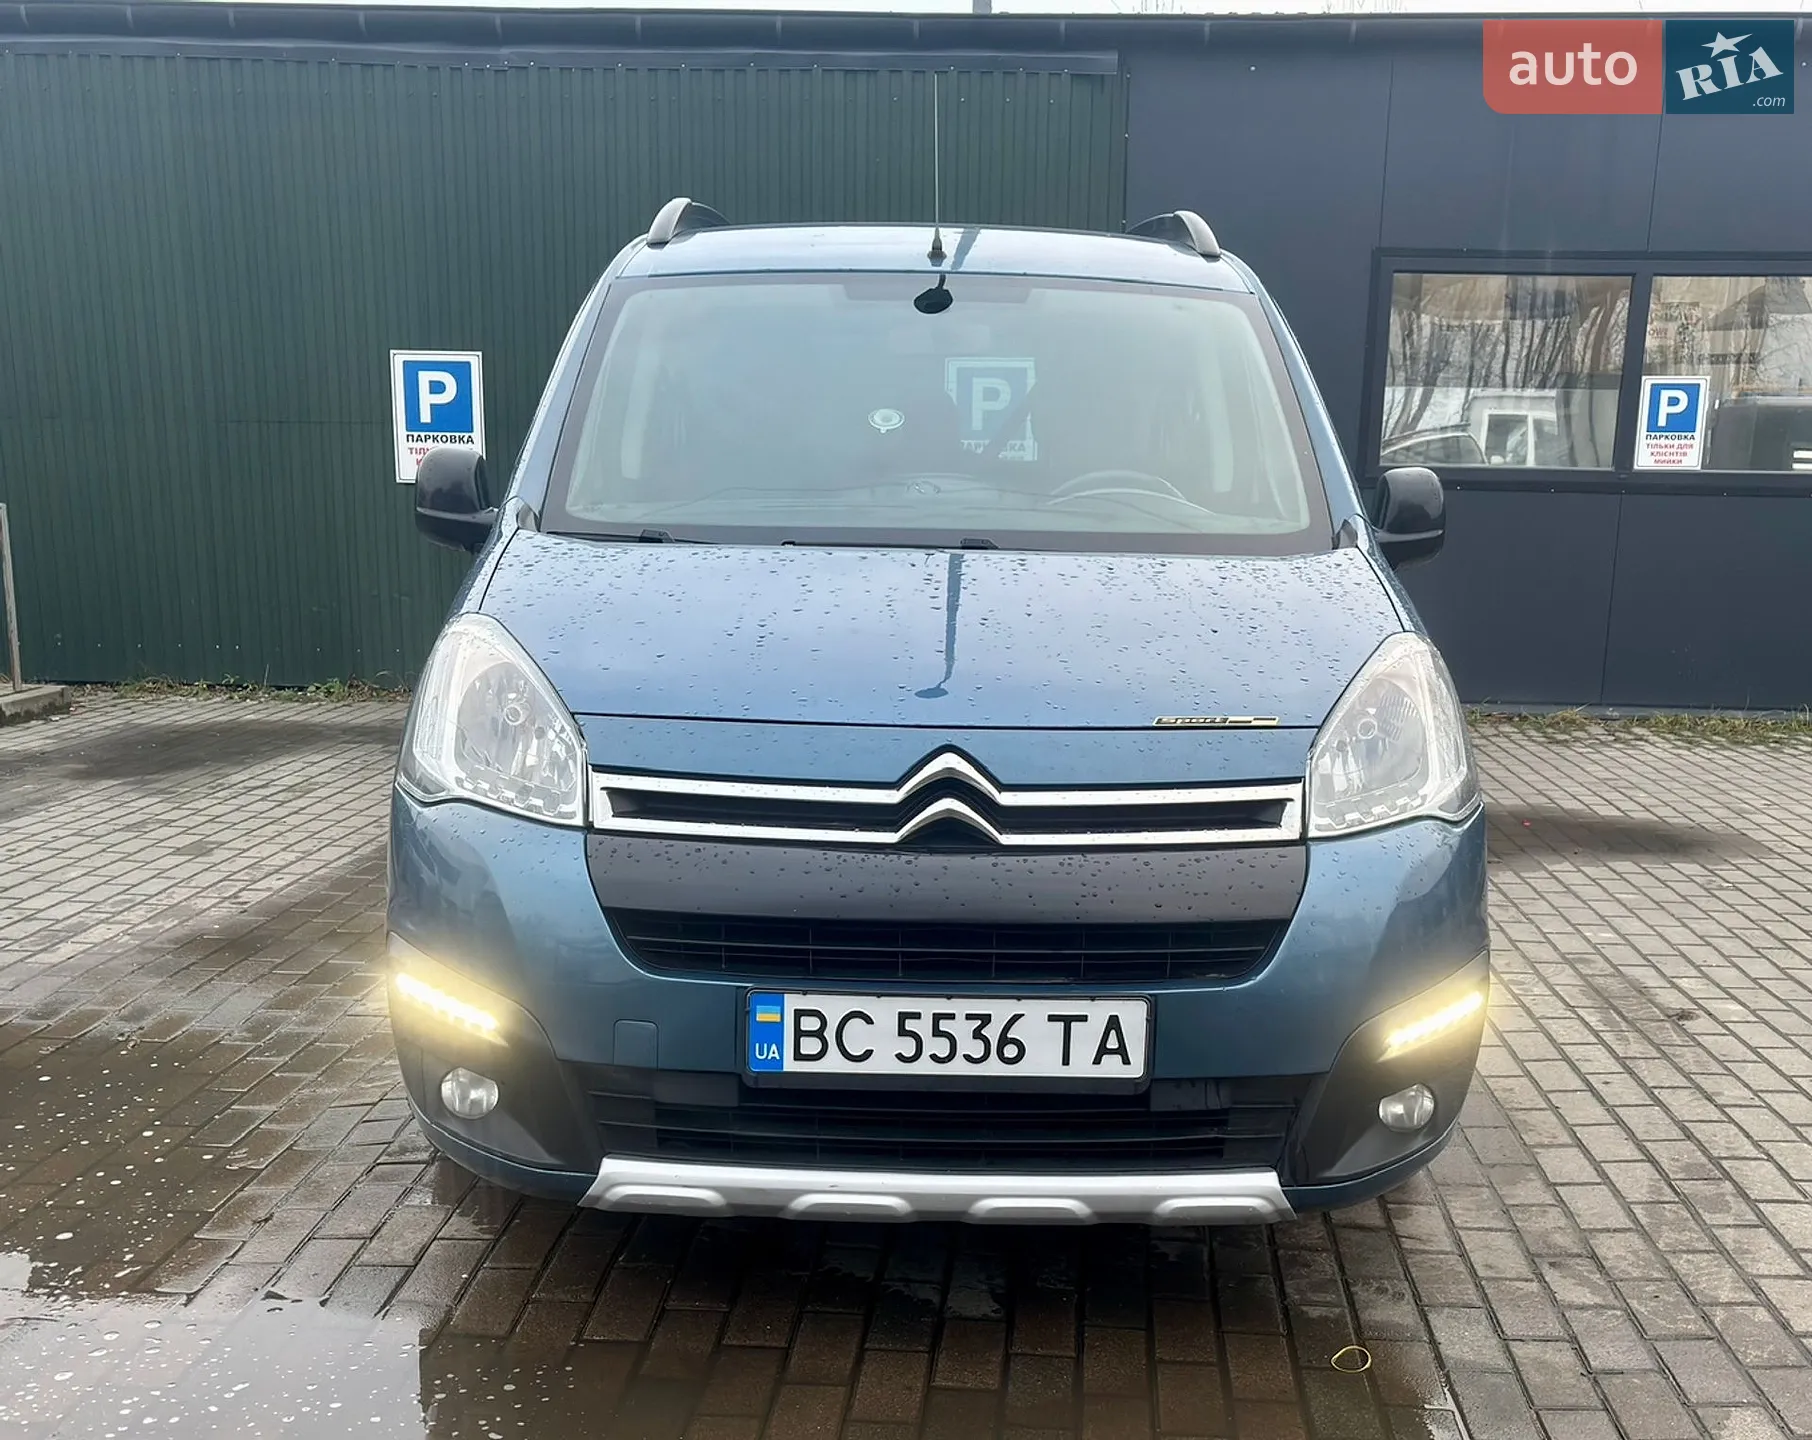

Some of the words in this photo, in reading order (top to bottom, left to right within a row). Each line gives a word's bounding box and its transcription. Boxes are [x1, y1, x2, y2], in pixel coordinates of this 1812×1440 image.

[417, 370, 458, 424] P
[1657, 389, 1689, 427] P
[406, 434, 475, 445] ПАРКОВКА
[755, 1043, 781, 1061] UA
[793, 1008, 875, 1063] BC
[894, 1011, 1027, 1065] 5536
[1047, 1013, 1132, 1066] TA
